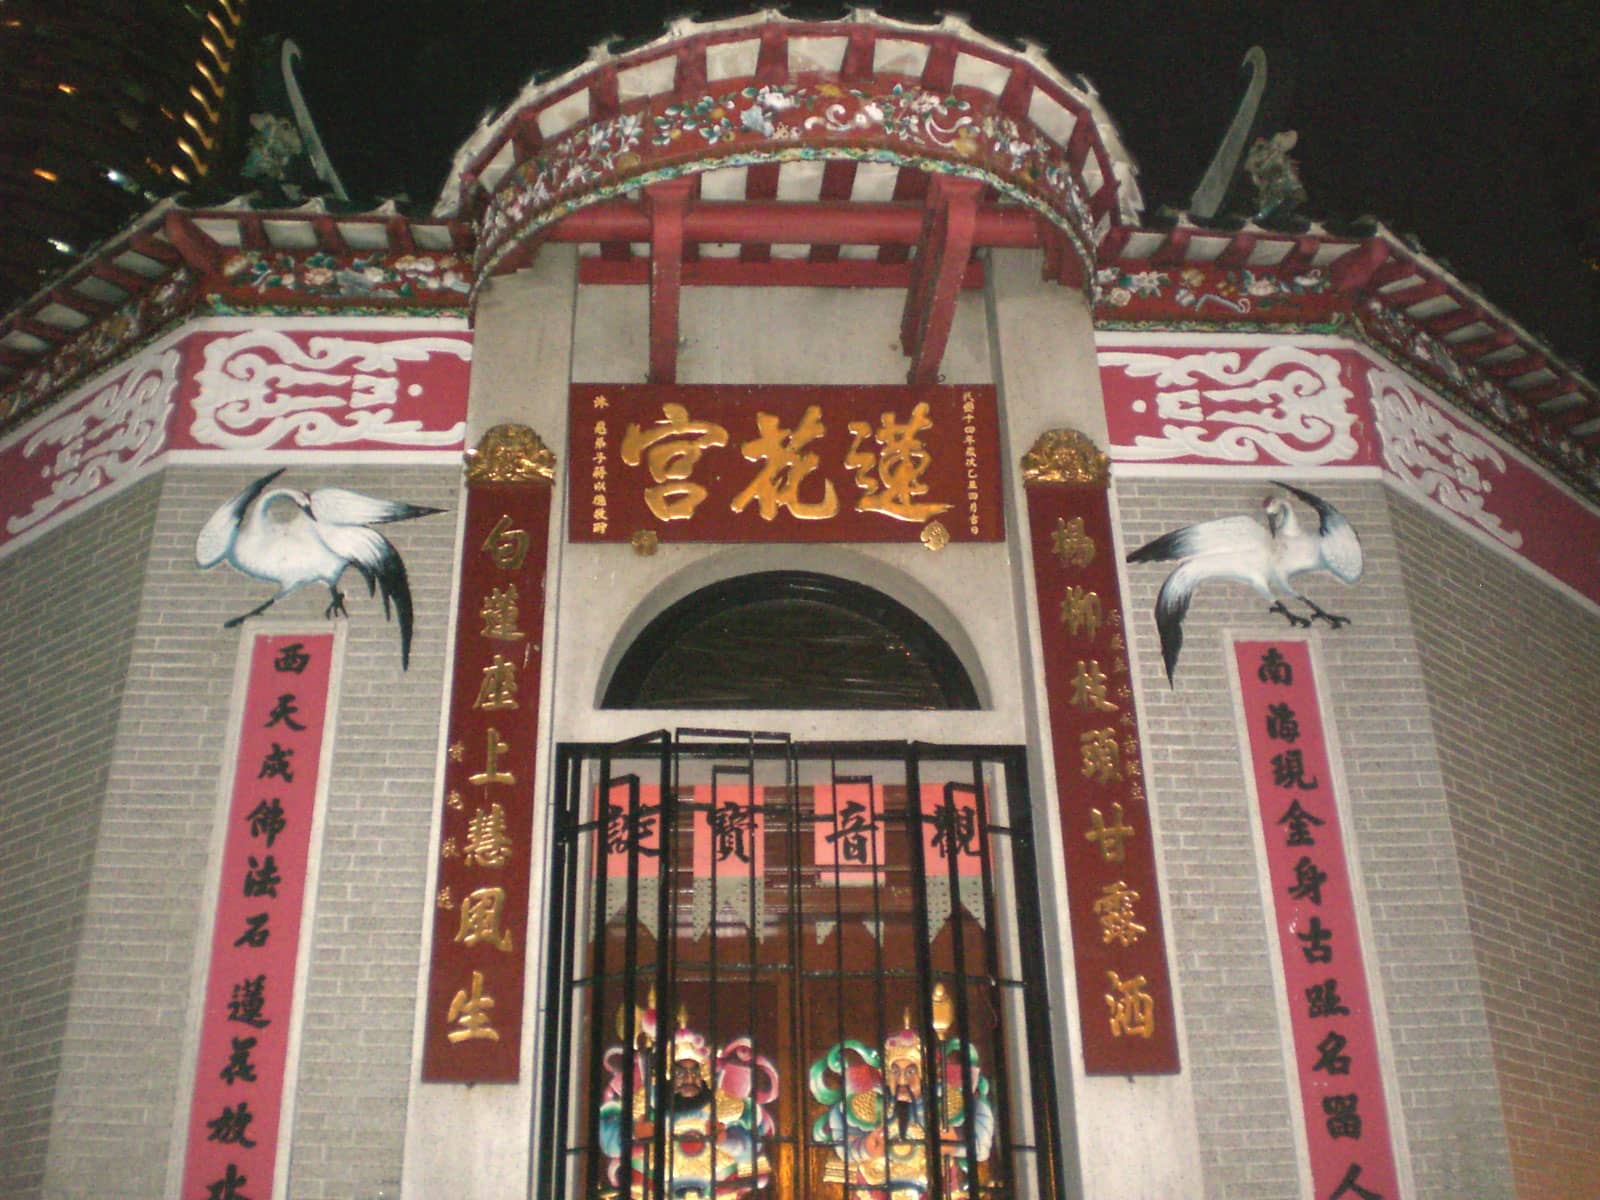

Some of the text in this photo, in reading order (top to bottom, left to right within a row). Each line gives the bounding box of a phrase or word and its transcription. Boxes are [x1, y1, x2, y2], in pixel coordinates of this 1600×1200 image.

[621, 402, 955, 522] 蓮花宮
[447, 514, 532, 1043] 白蓮座上慧風生
